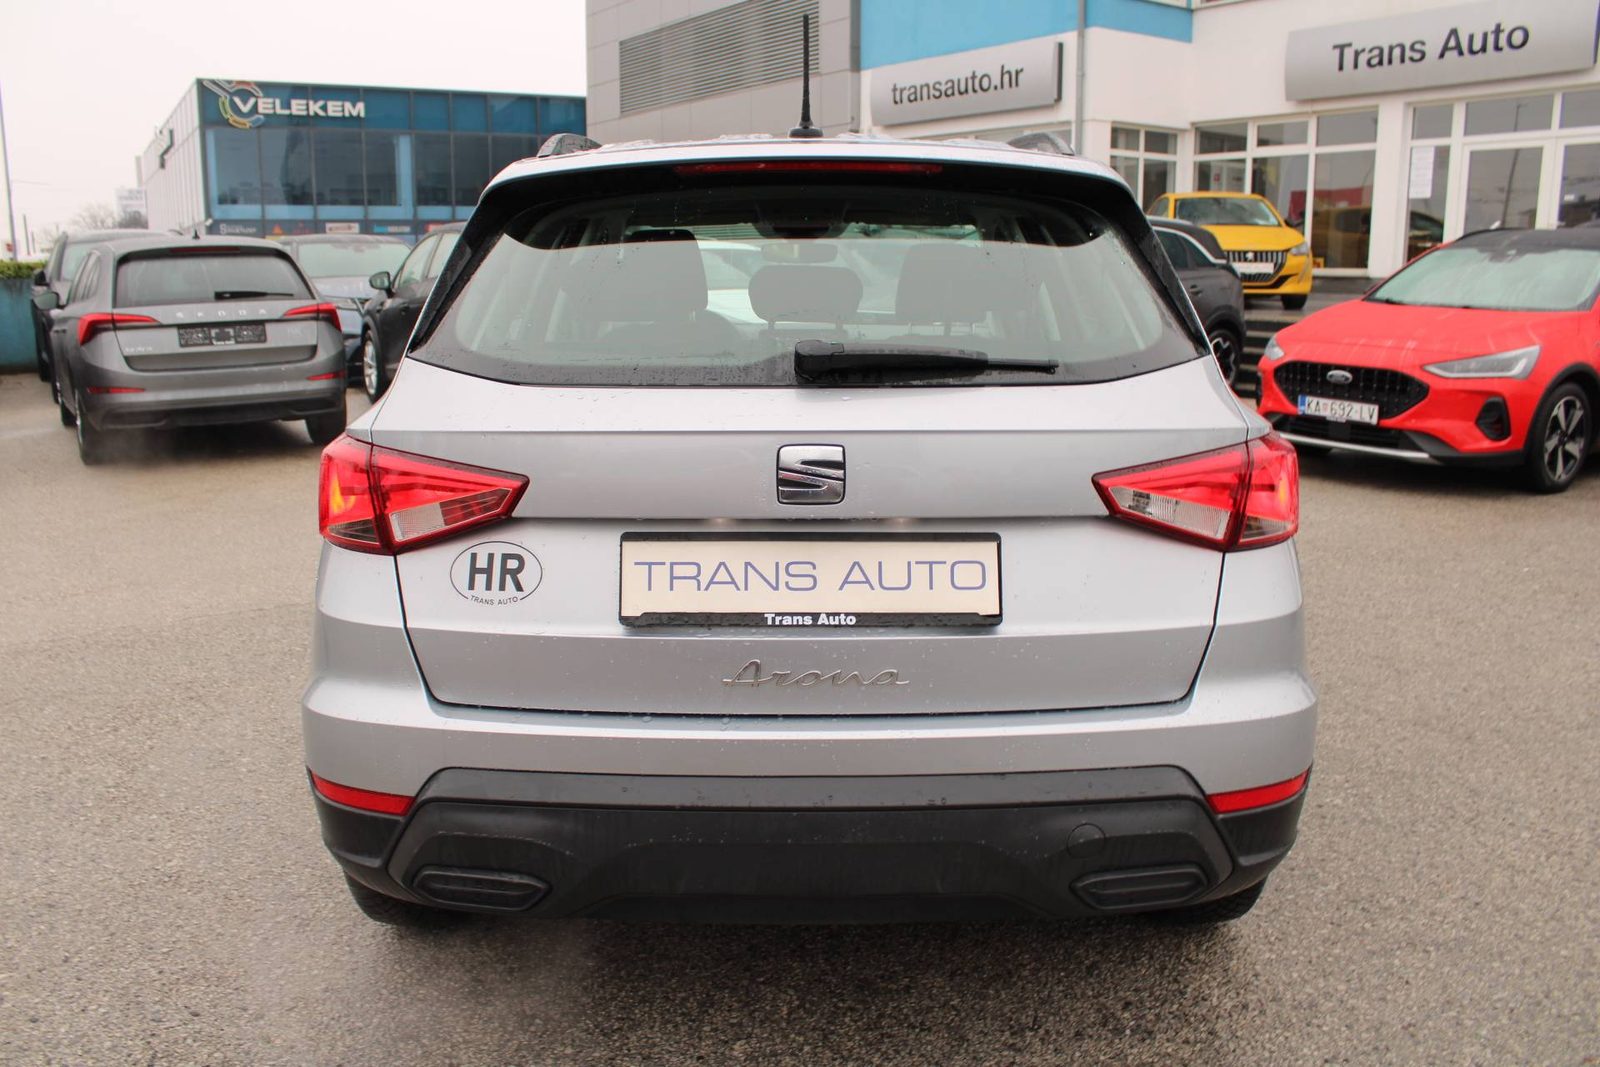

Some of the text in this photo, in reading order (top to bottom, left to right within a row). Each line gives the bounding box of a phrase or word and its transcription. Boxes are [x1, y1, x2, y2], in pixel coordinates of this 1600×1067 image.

[1332, 22, 1530, 73] Trans Auto
[891, 64, 1024, 105] transauto.hr
[232, 96, 366, 119] VELEKEM
[467, 552, 526, 593] HR
[633, 559, 987, 592] TRANS AUTO
[470, 595, 519, 606] TRANS AUTO
[763, 613, 858, 626] Trans Auto
[721, 658, 910, 688] Arona
